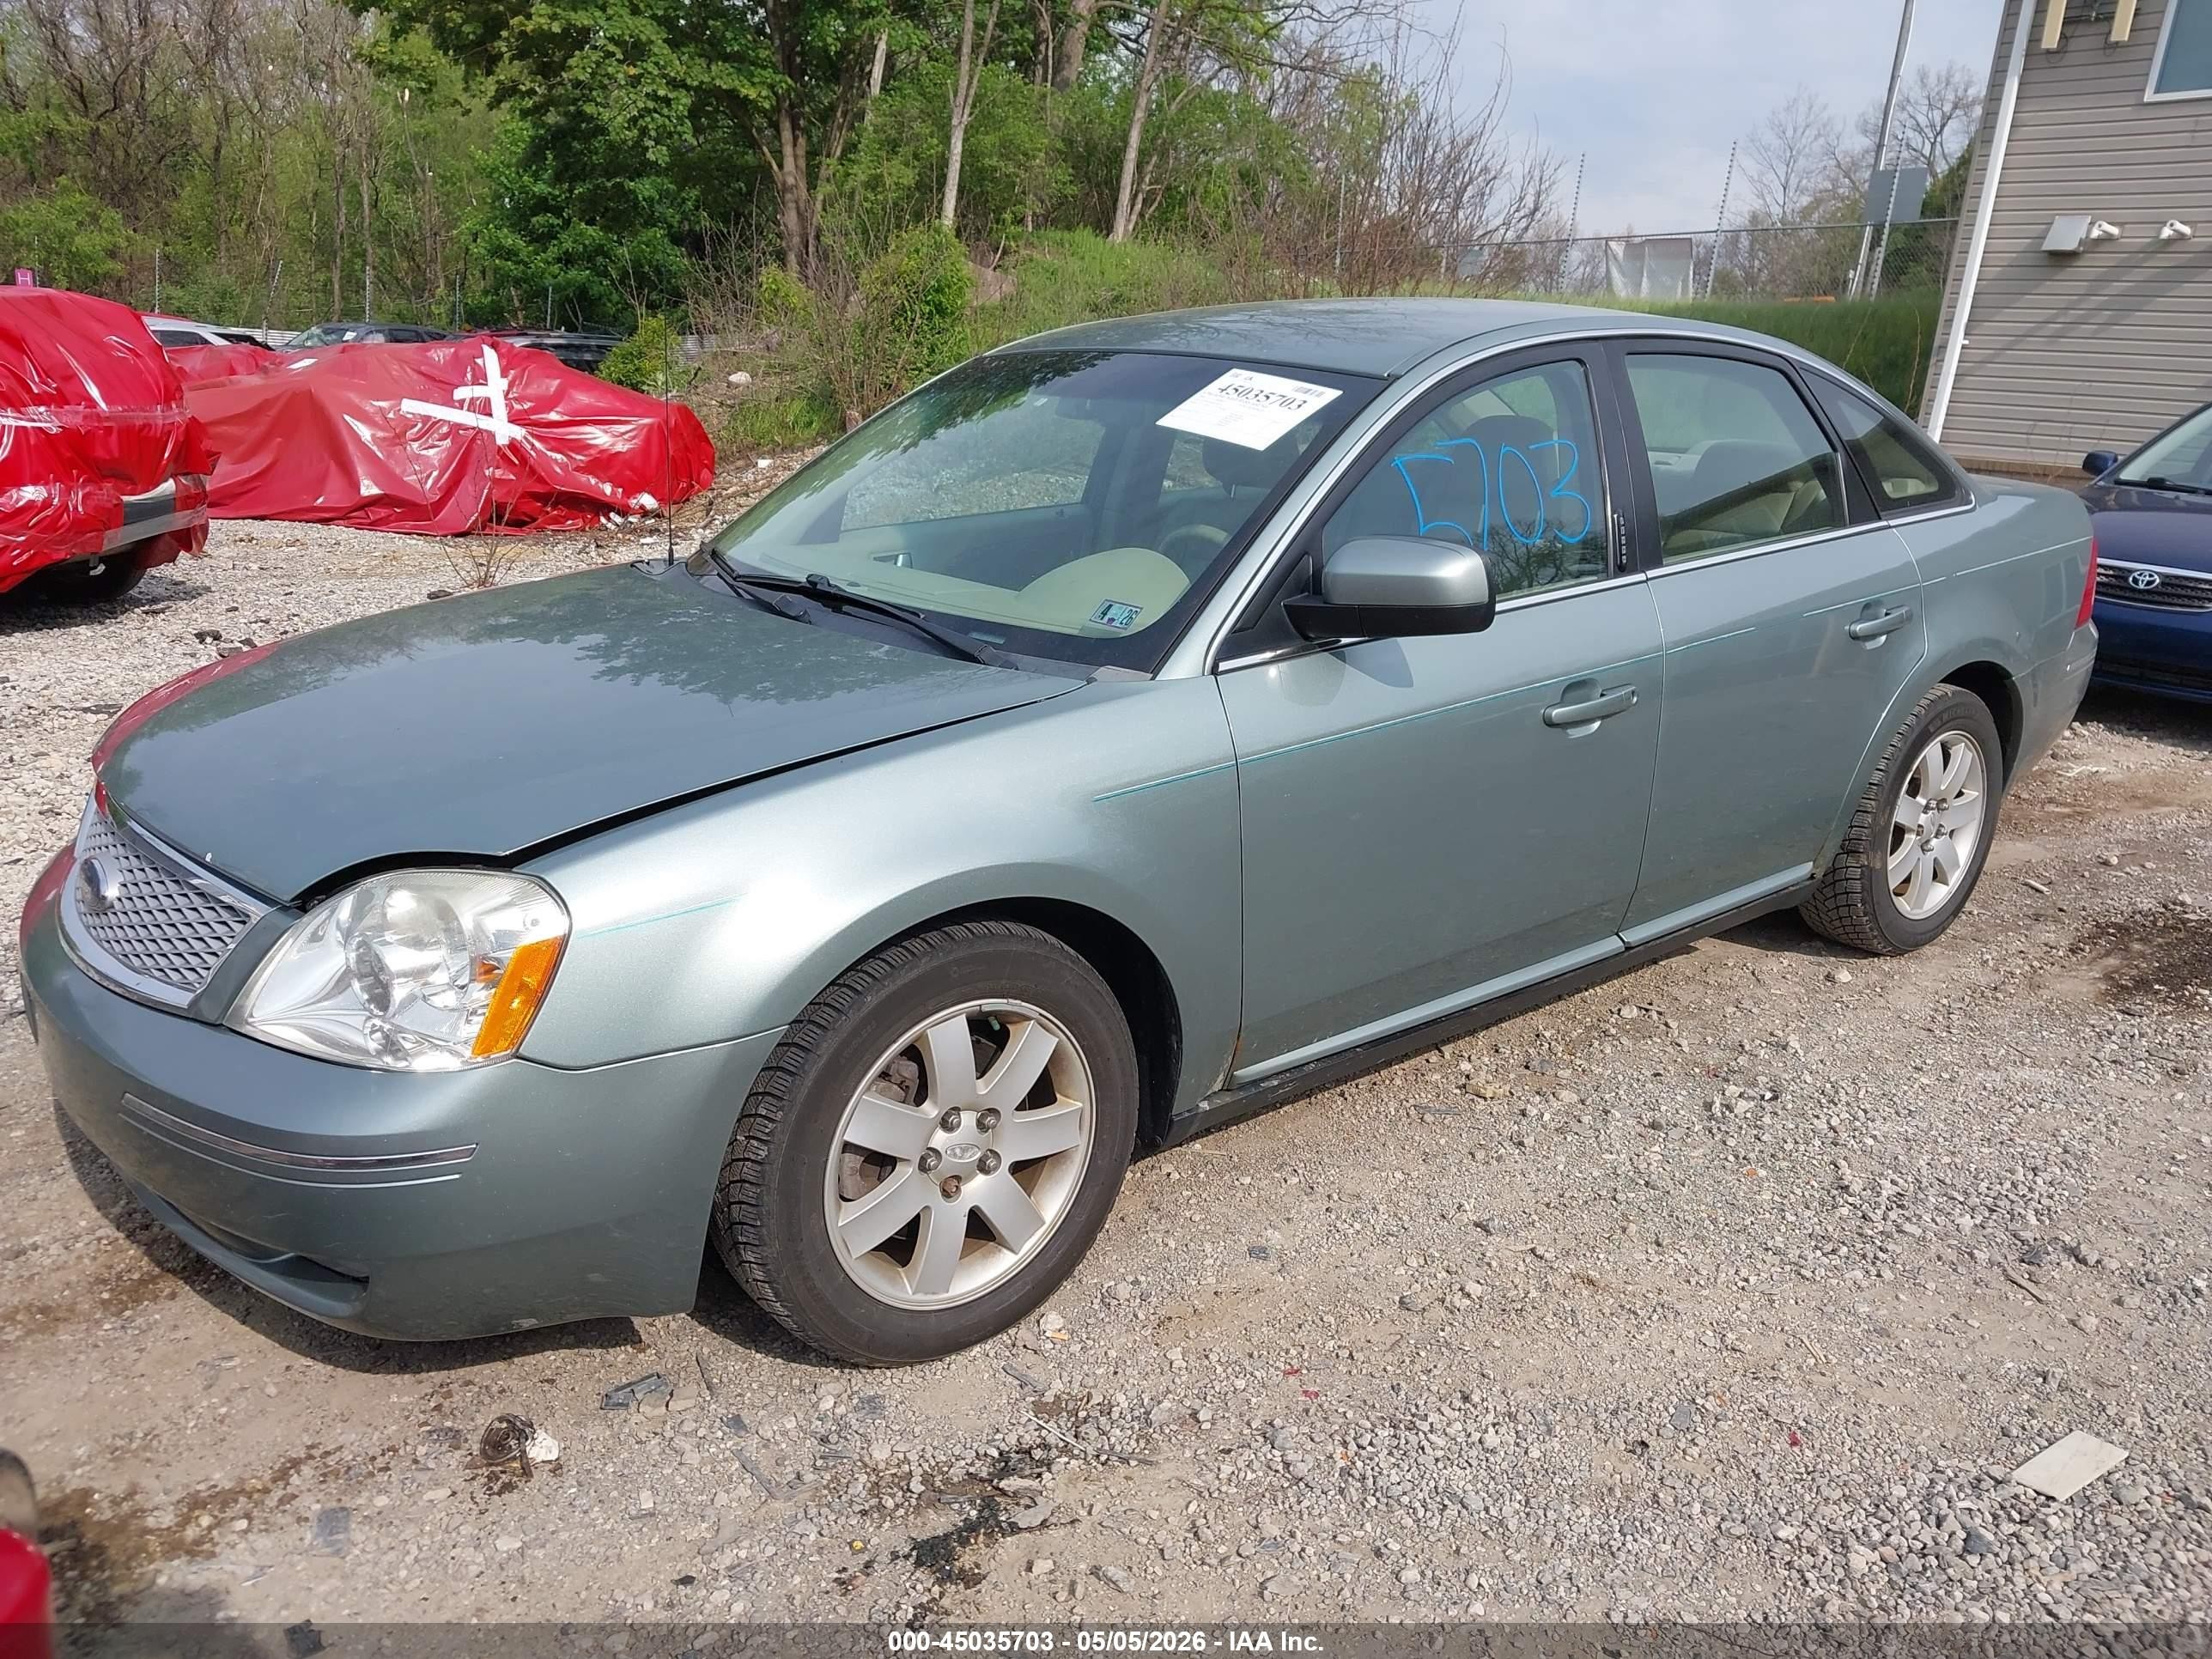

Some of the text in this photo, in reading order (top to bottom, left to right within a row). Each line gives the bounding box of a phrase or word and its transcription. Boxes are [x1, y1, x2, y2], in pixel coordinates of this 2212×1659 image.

[1217, 383, 1308, 410] 45035703
[1391, 438, 1591, 551] 5703
[1098, 604, 1138, 626] 4 26
